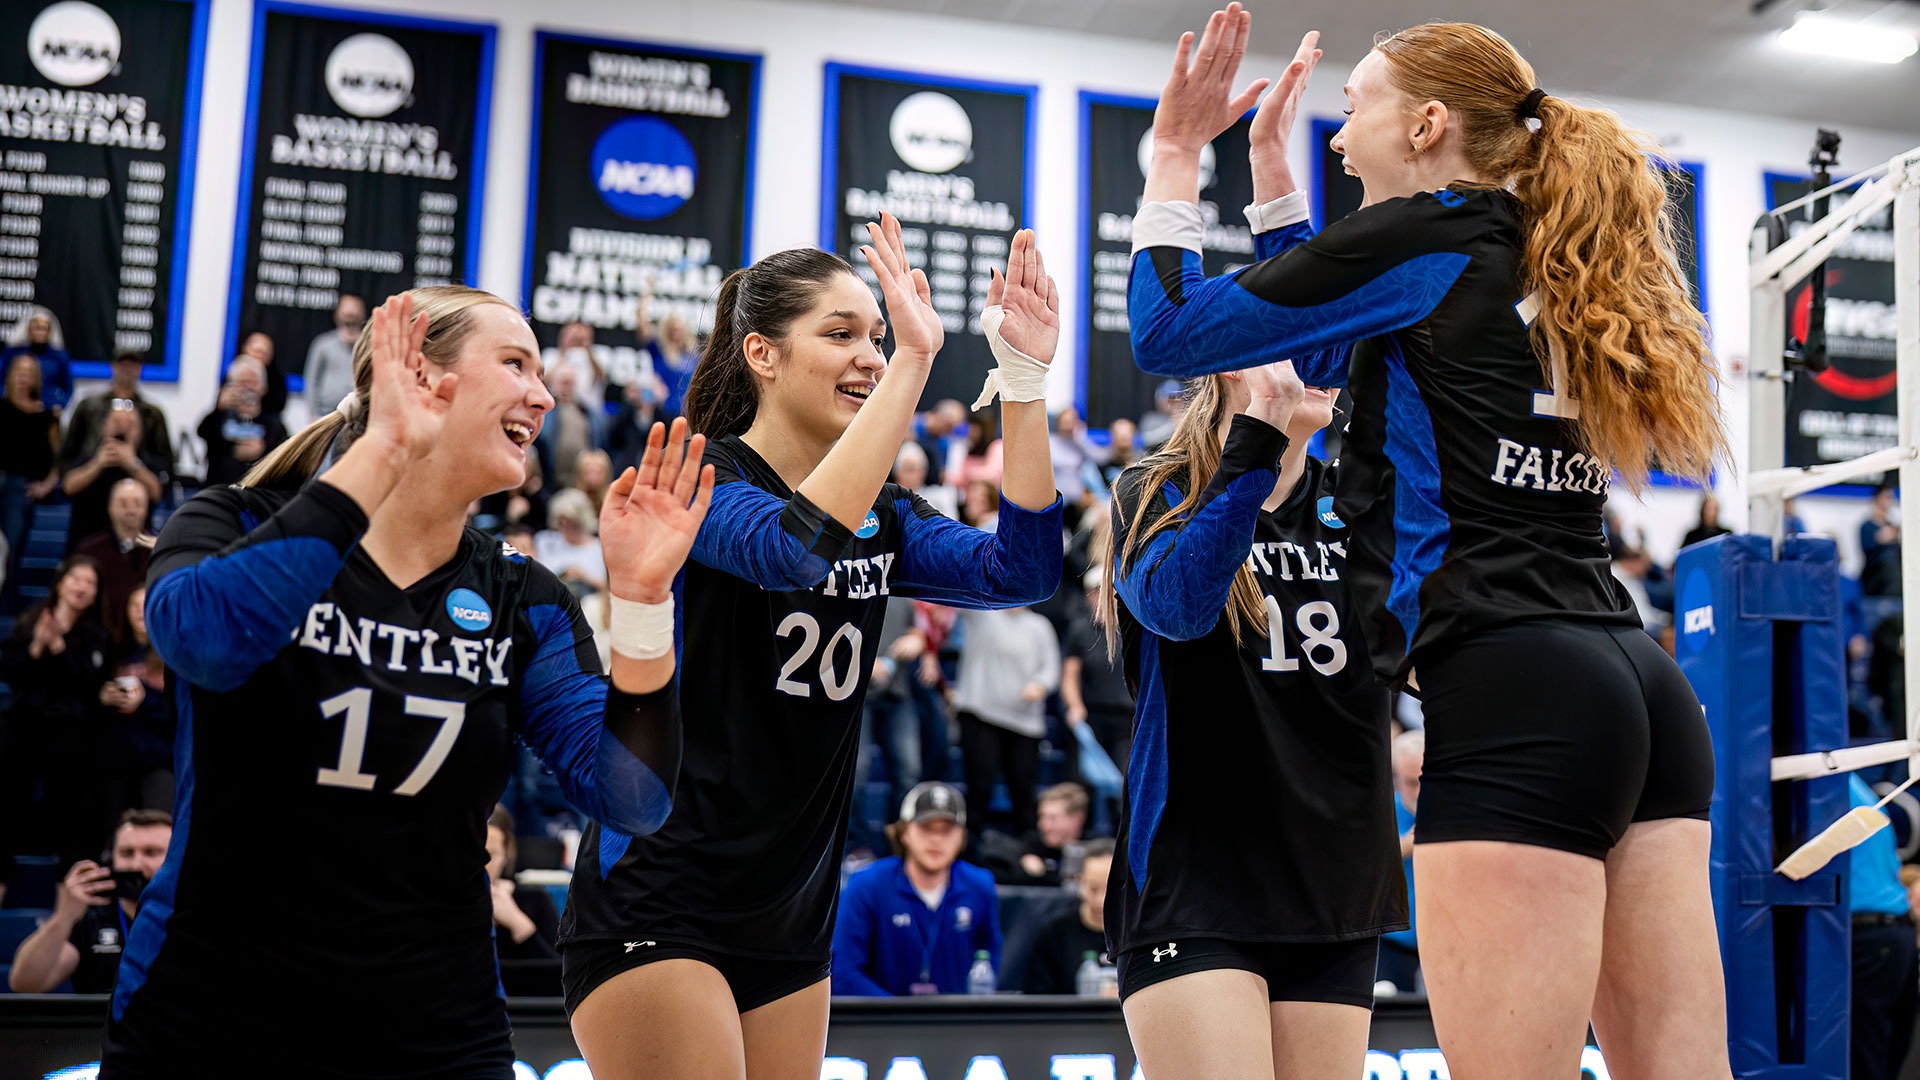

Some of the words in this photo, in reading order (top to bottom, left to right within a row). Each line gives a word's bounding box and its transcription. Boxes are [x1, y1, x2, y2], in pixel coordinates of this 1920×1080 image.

[270, 134, 458, 180] BASKETBALL
[293, 113, 439, 155] WOMEN'S
[599, 158, 696, 200] NCAA
[1321, 512, 1338, 522] NC
[822, 552, 895, 599] TLEY
[1250, 541, 1347, 581] NTLE
[452, 606, 490, 622] NCAA
[1262, 594, 1348, 676] 18
[291, 602, 513, 686] ENTLEY
[776, 611, 863, 701] 20
[316, 686, 467, 797] 17
